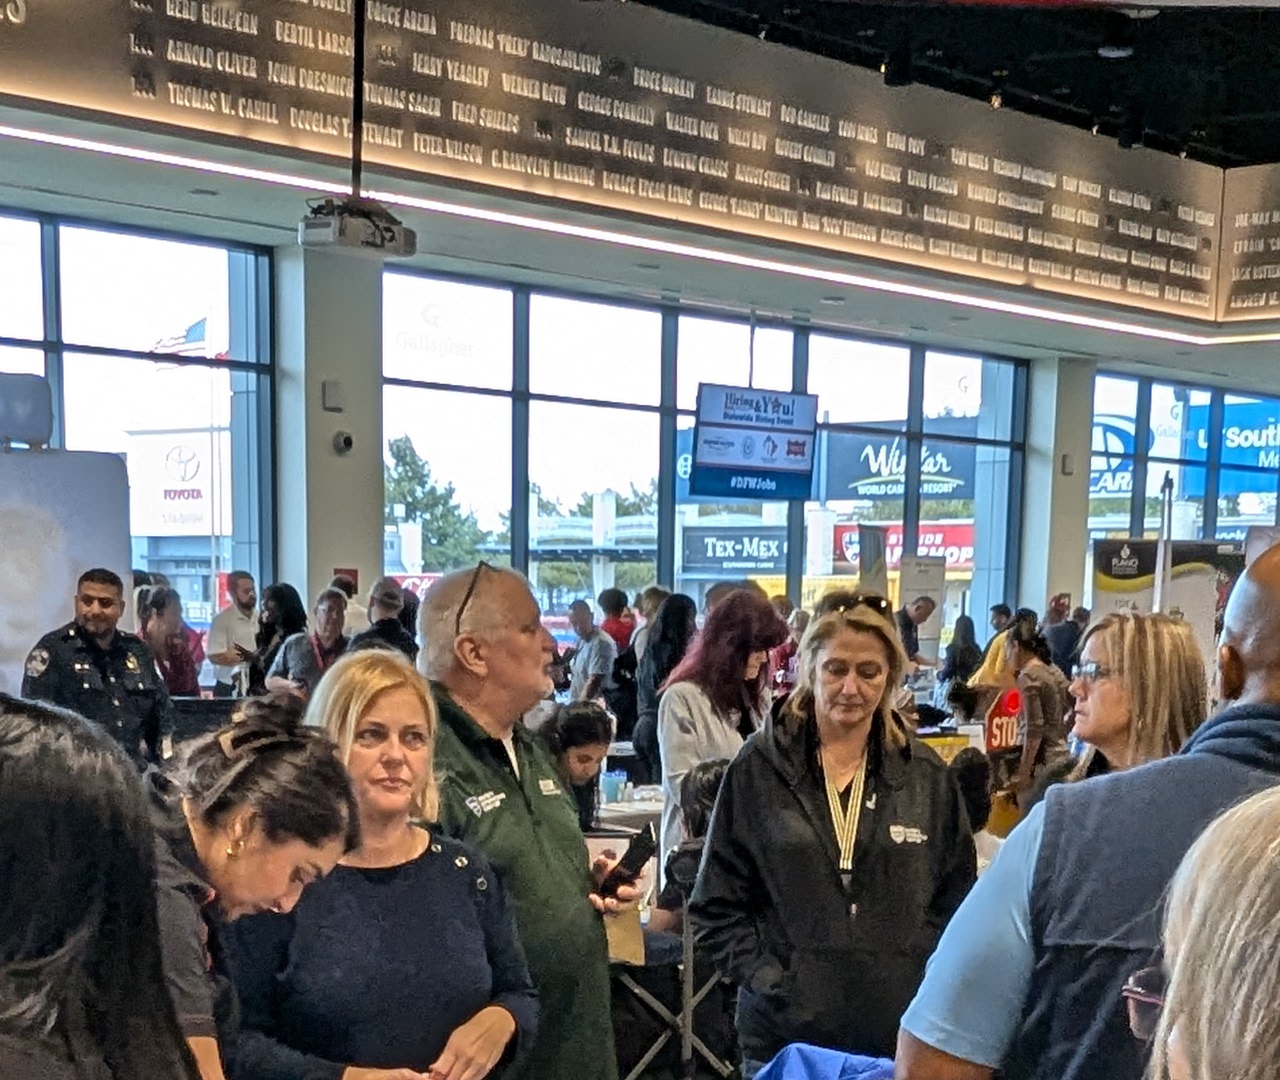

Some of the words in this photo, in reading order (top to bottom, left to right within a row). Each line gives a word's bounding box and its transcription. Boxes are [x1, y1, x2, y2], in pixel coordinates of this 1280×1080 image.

[168, 82, 215, 112] THOMAS
[363, 81, 407, 110] THOMAS
[860, 437, 952, 480] Witar
